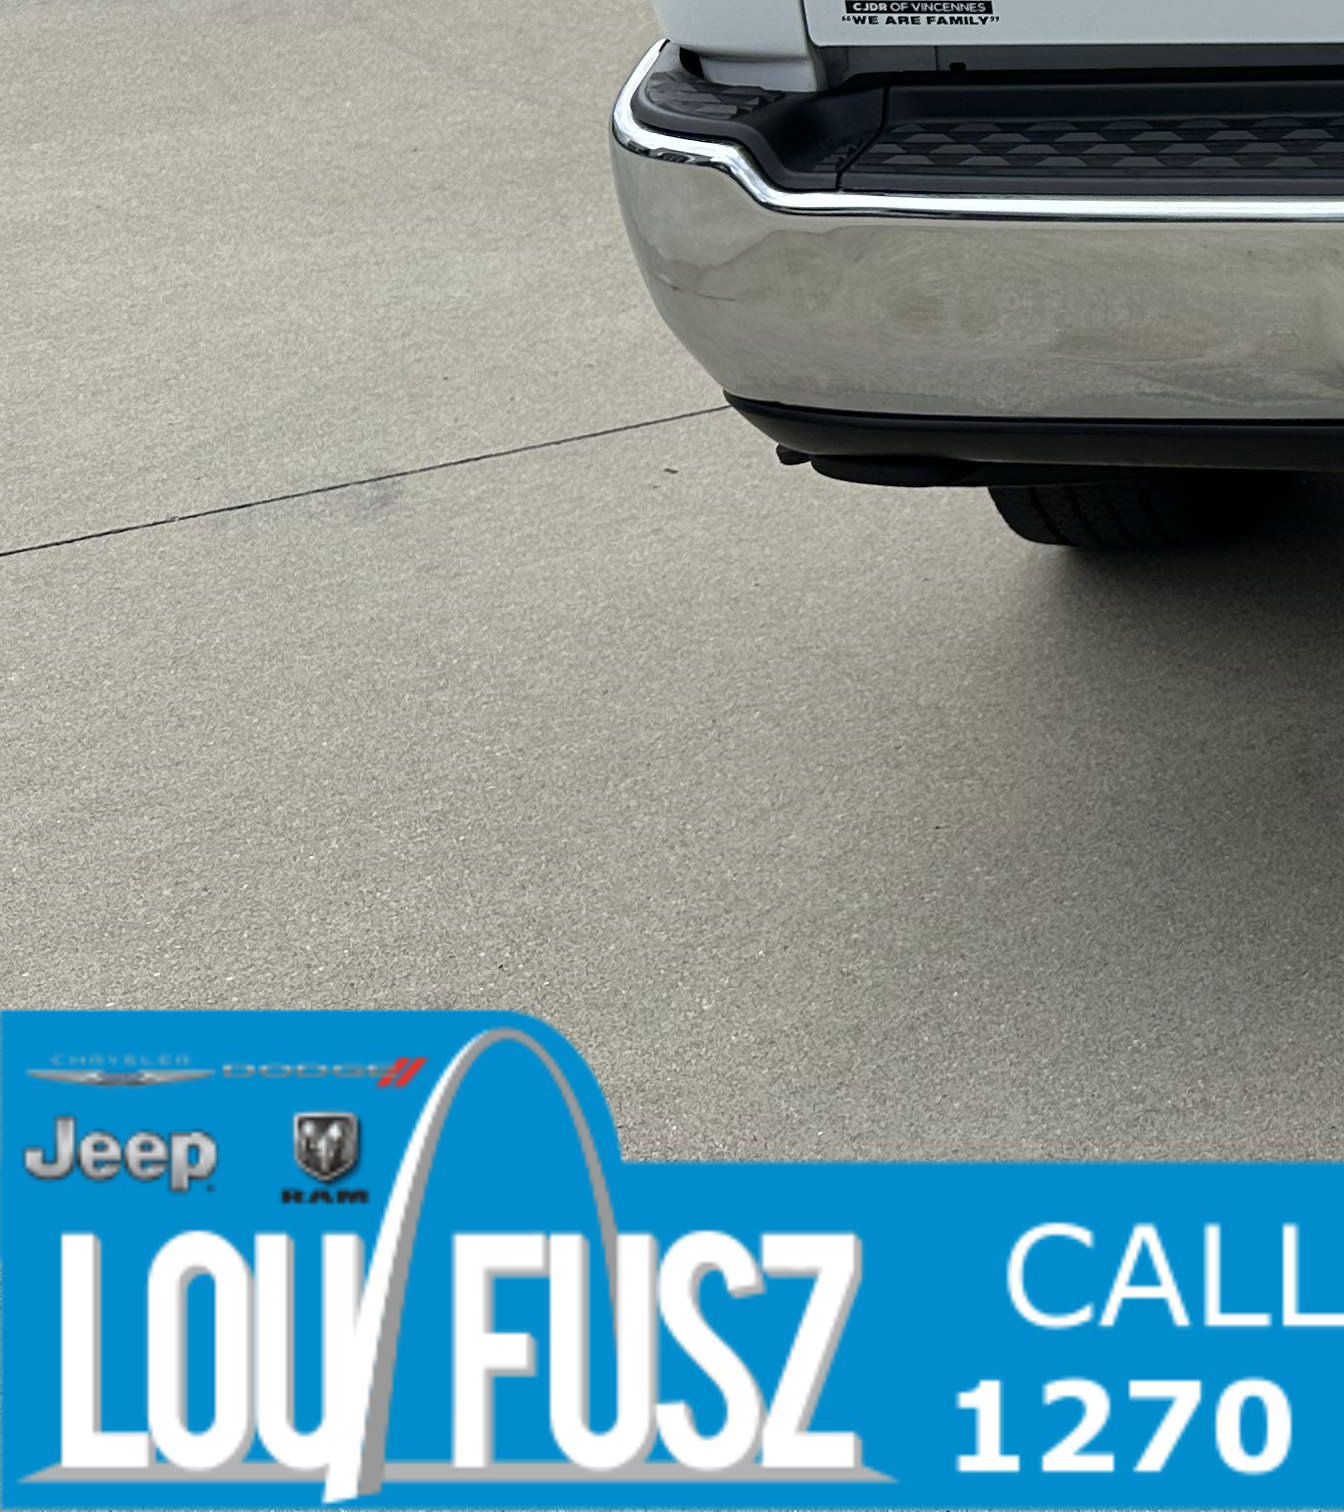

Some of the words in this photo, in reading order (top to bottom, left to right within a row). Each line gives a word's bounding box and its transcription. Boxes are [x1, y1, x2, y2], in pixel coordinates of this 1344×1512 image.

[852, 2, 888, 12] CJDR
[890, 2, 909, 11] OF
[910, 2, 986, 12] VINCENNES
[885, 16, 921, 25] ARE
